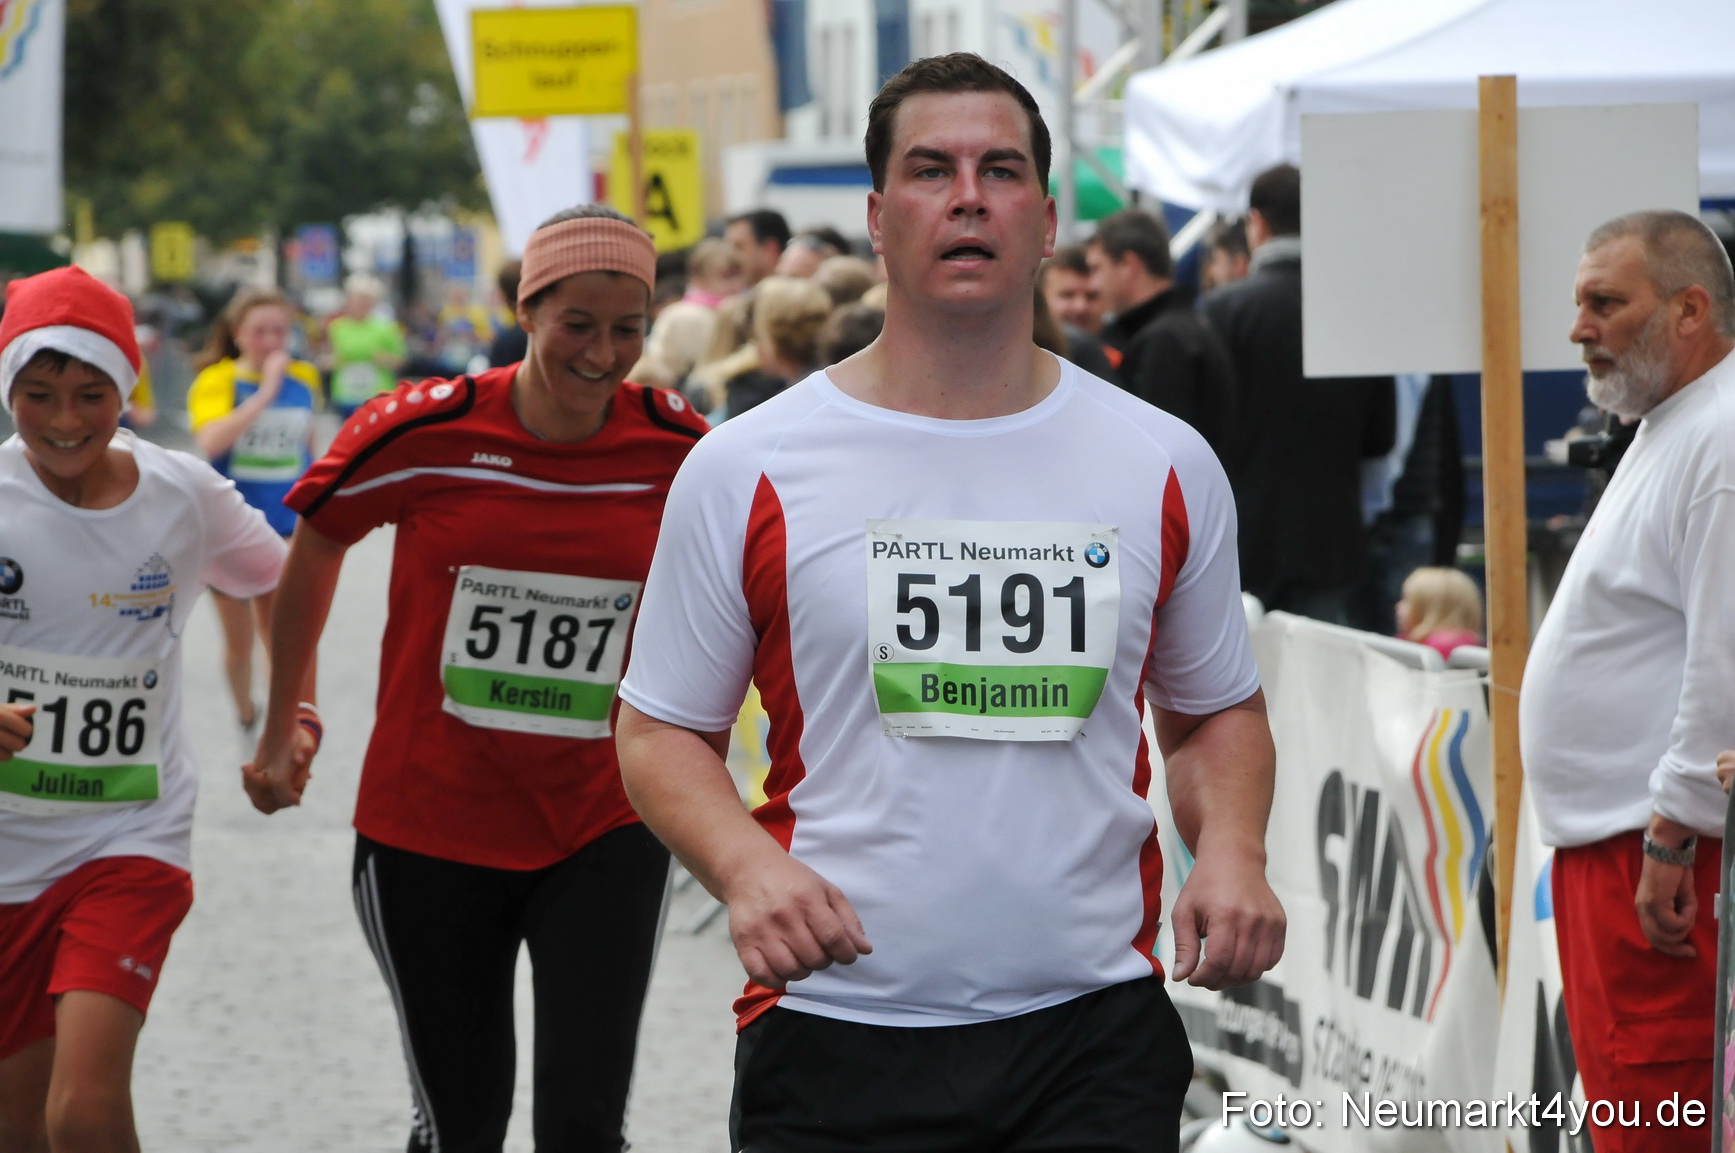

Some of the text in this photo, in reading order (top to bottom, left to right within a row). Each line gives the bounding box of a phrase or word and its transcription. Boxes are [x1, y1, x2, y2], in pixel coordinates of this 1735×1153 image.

[642, 168, 679, 231] A
[471, 452, 513, 467] JAKO
[872, 541, 1074, 563] PARTL Neumarkt
[460, 578, 609, 610] PARTL Neumarkt
[896, 572, 1085, 654] 5191
[466, 604, 616, 673] 5187
[879, 646, 888, 660] S
[55, 671, 138, 689] Neumarkt
[490, 679, 571, 711] Kerstin
[921, 674, 1069, 715] Benjamin
[31, 770, 104, 797] Julian
